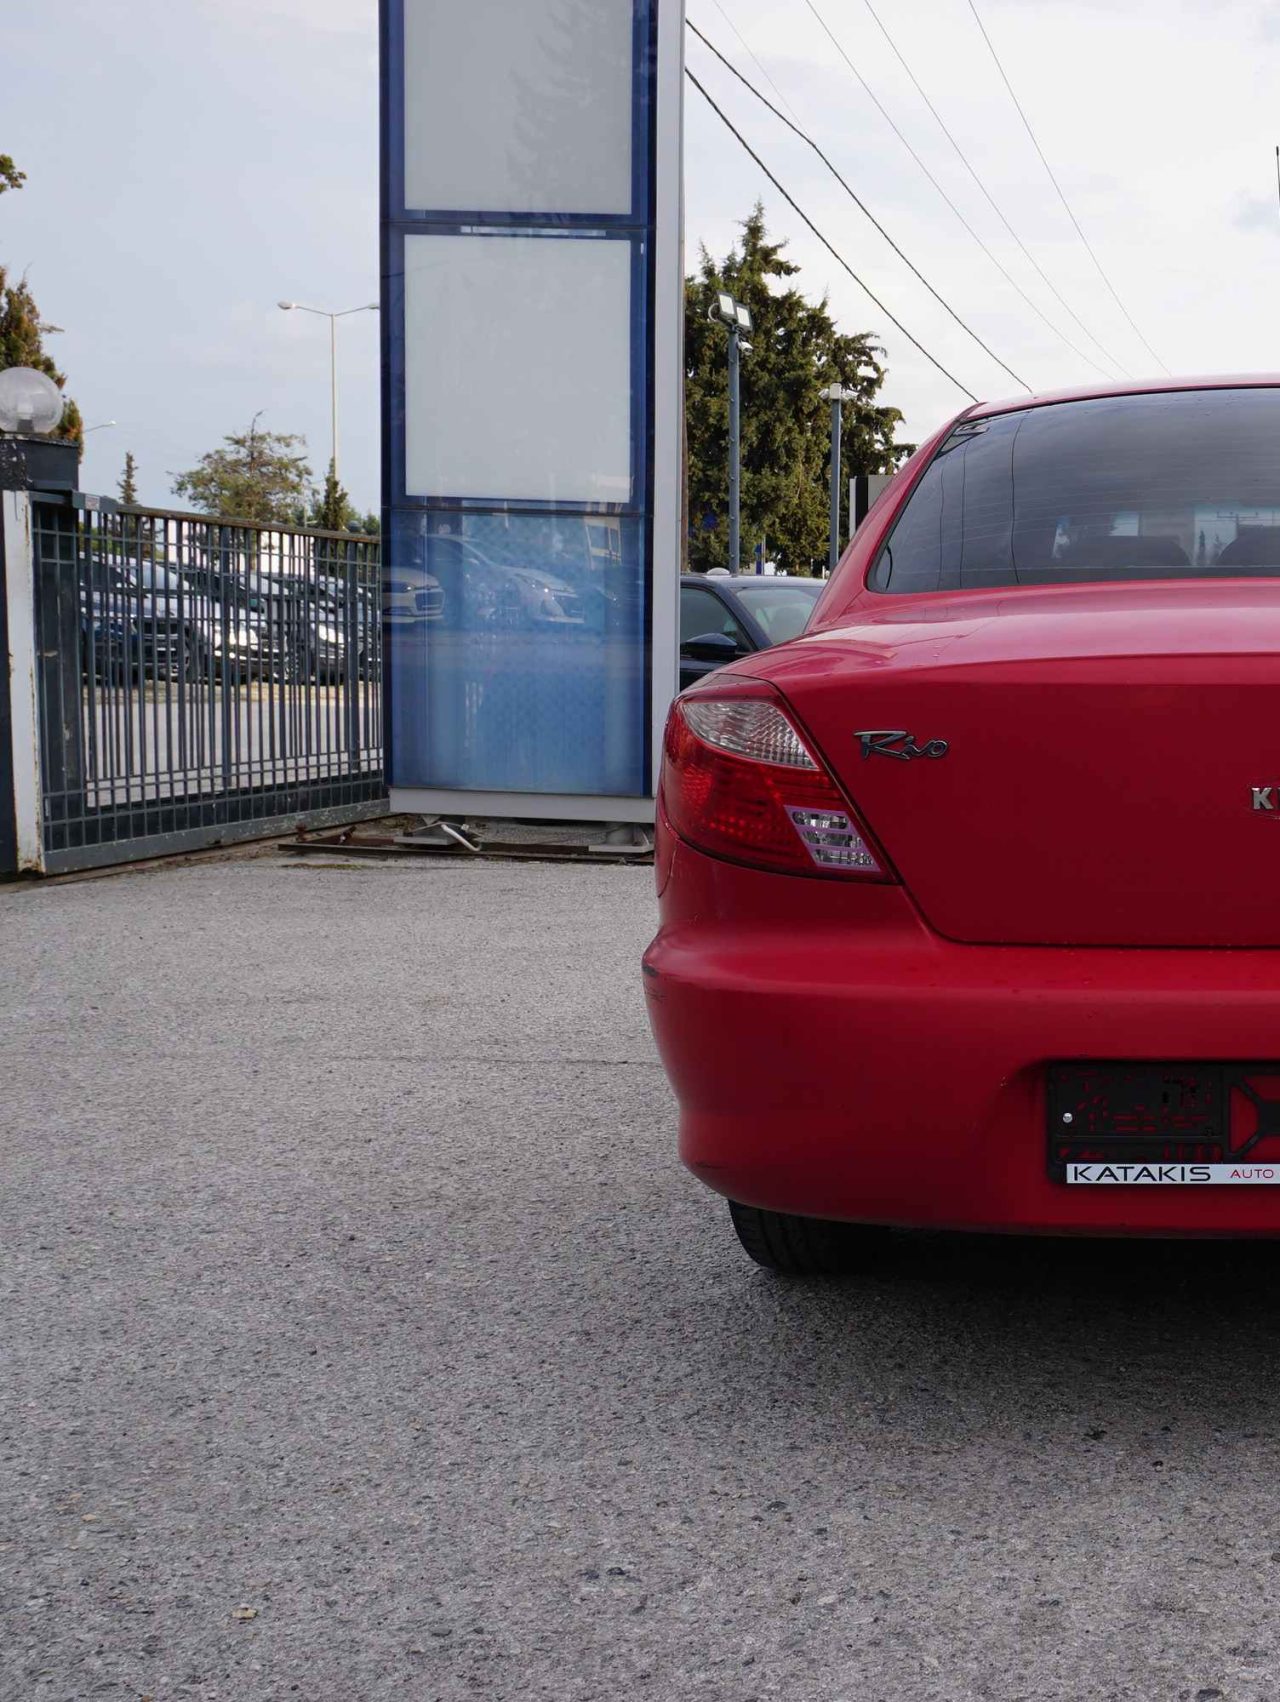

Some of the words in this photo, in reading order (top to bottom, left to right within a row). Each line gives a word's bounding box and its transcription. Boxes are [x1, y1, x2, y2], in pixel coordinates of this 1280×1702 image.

[854, 730, 948, 759] Rio
[1073, 1165, 1212, 1182] KATAKIS
[1230, 1168, 1274, 1179] AUTO
